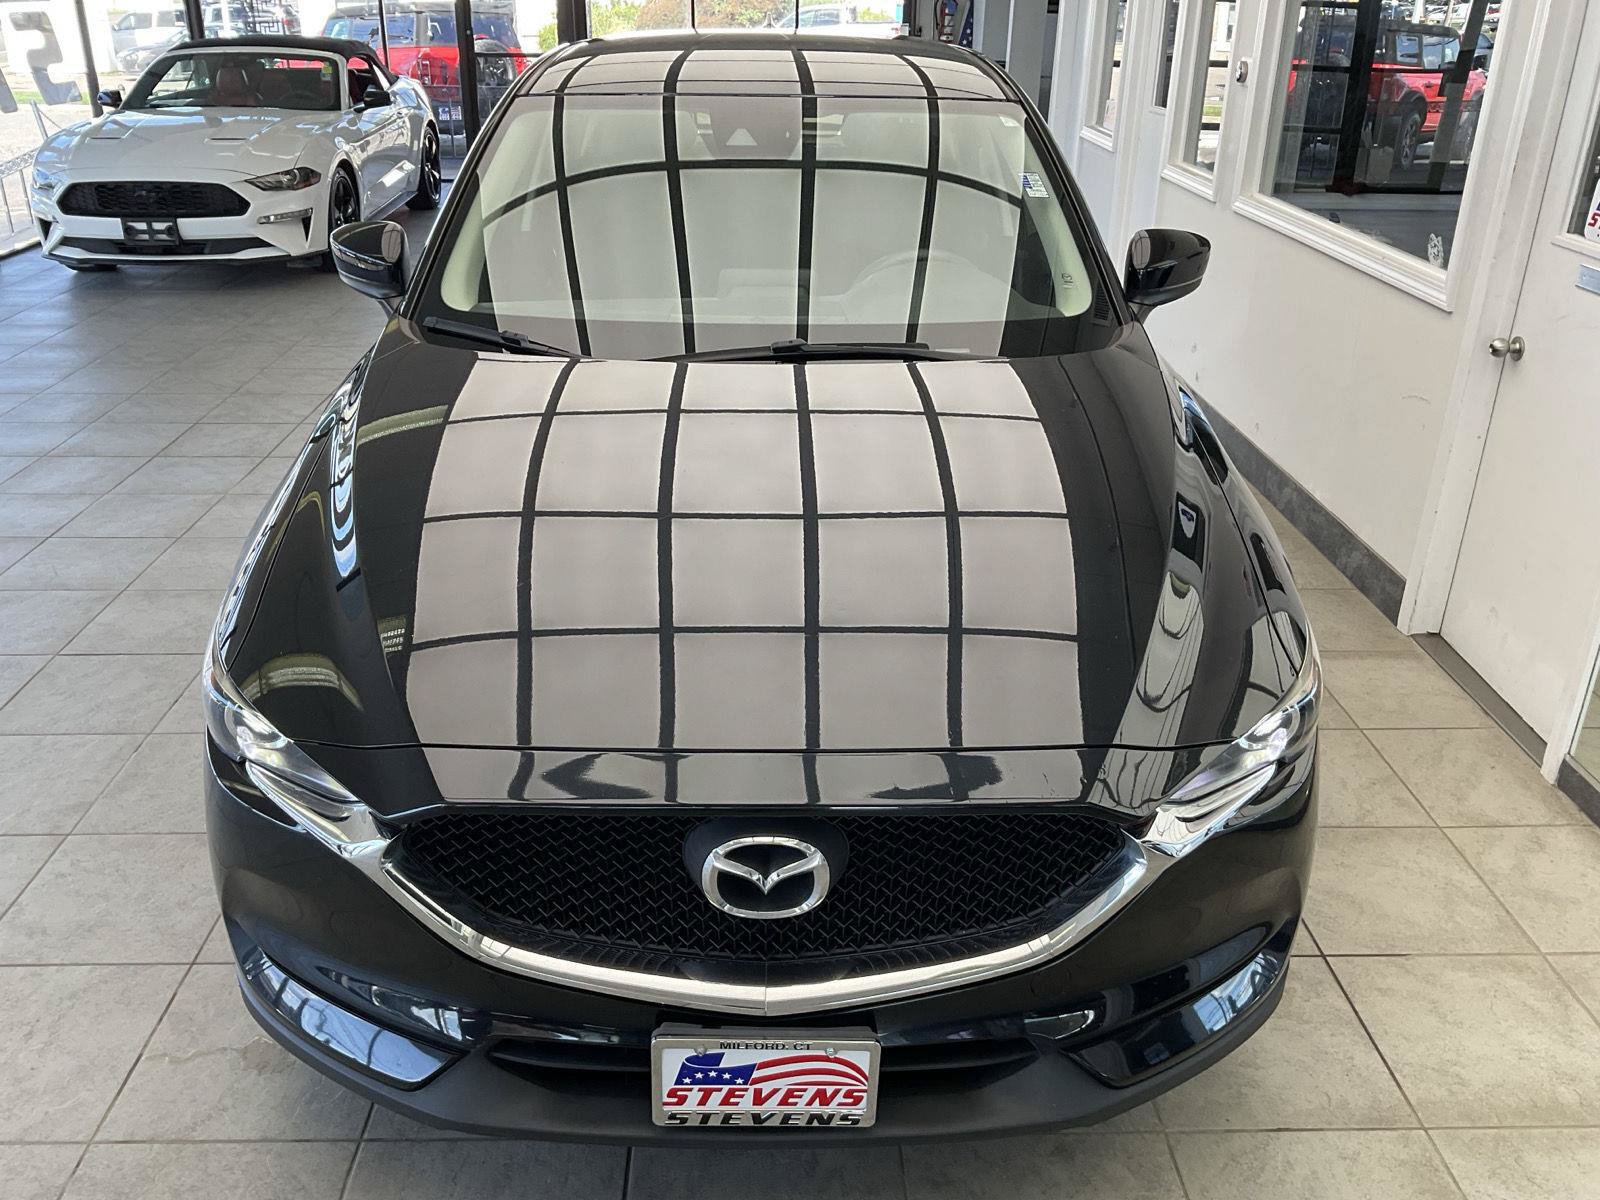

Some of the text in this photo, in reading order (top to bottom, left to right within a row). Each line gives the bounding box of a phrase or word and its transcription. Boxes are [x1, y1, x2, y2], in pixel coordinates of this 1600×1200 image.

[794, 1042, 813, 1050] CT
[662, 1087, 867, 1106] STEVENS
[665, 1111, 863, 1125] STEVENS
